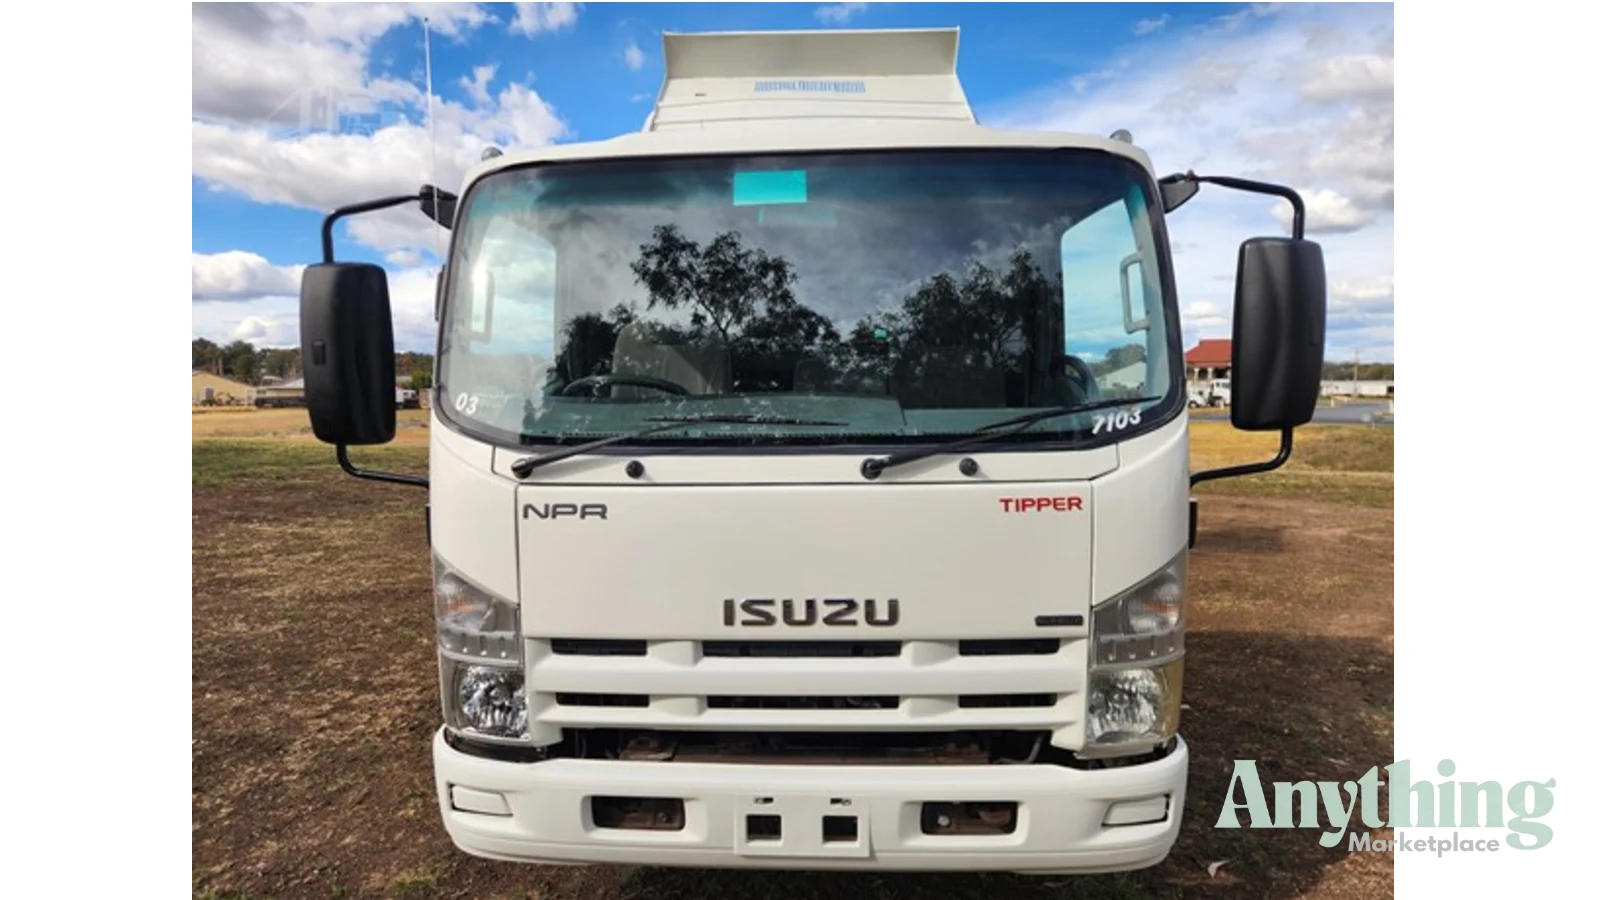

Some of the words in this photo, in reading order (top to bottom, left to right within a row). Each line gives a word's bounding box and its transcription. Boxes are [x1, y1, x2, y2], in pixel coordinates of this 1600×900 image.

[1091, 408, 1143, 435] 7103
[523, 503, 608, 519] NPR
[999, 496, 1083, 513] TIPPER
[723, 598, 900, 627] ISUZU
